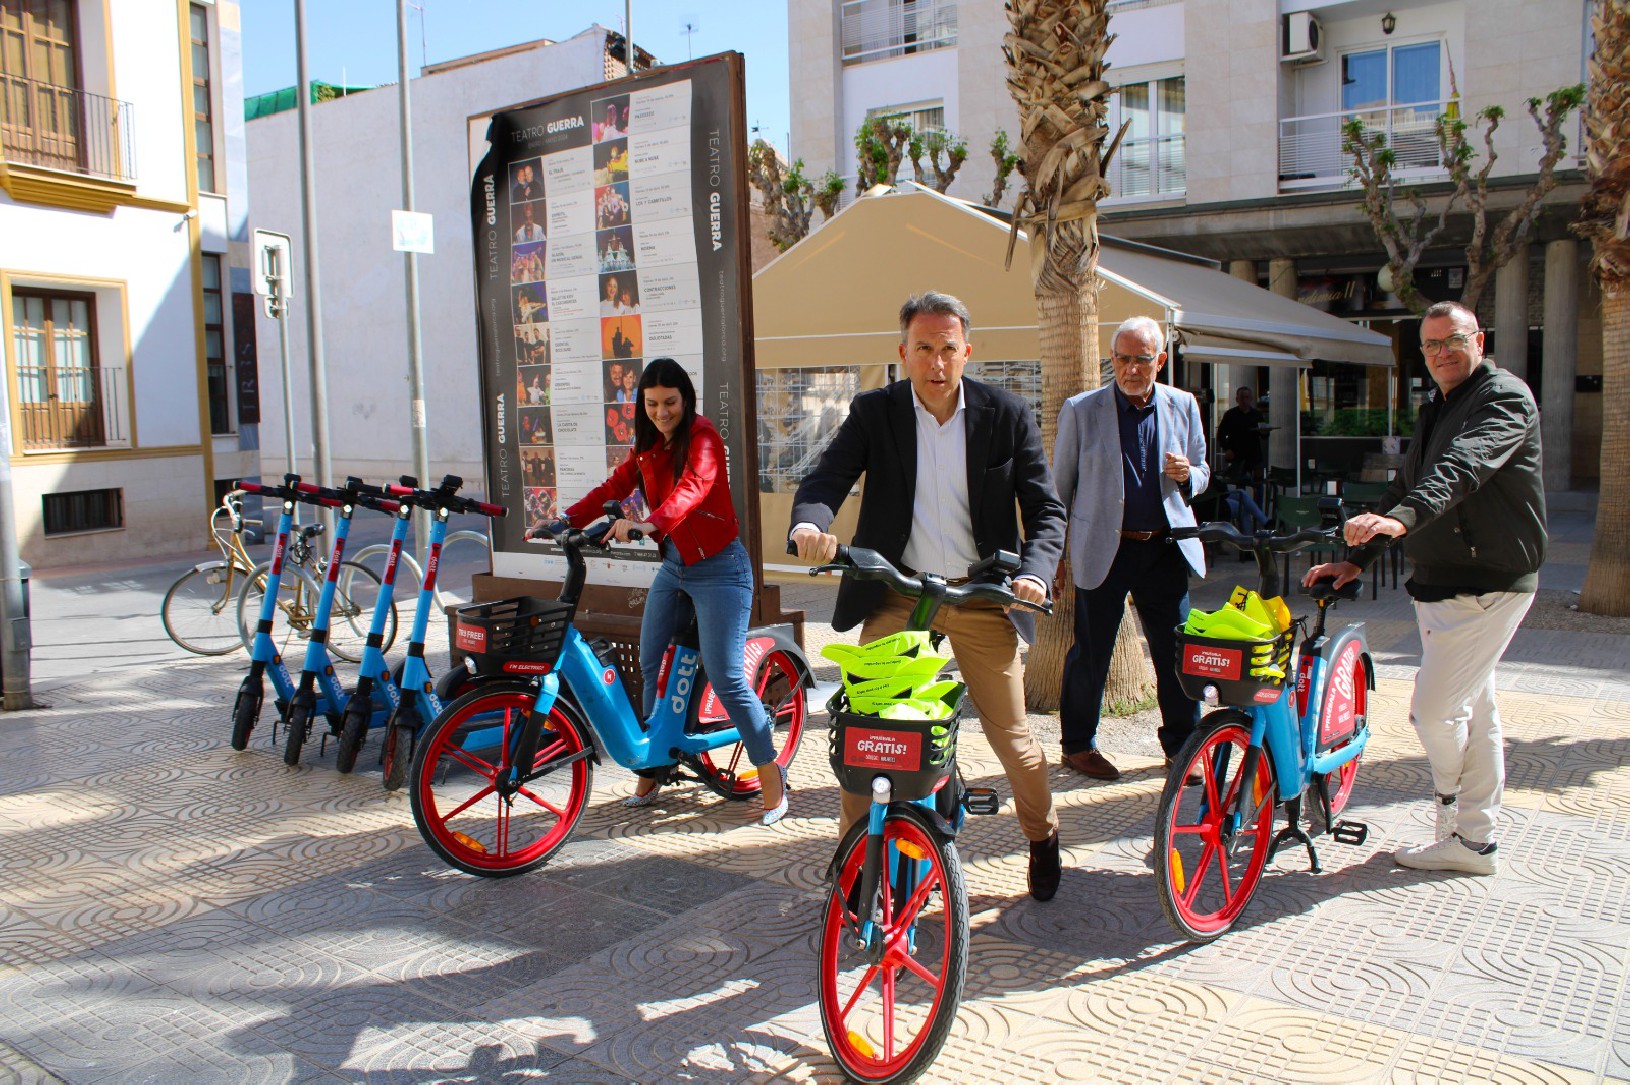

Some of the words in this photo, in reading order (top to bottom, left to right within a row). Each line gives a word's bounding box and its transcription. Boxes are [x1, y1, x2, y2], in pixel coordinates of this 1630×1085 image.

[511, 126, 545, 142] TEATRO
[547, 116, 584, 134] GUERRA
[709, 128, 720, 187] TEATRO
[483, 174, 497, 225] GUERRA
[710, 192, 722, 251] GUERRA
[489, 230, 499, 280] TEATRO
[497, 393, 506, 444] GUERRA
[719, 382, 730, 440] TEATRO
[500, 448, 510, 498] TEATRO
[389, 552, 397, 566] dott
[430, 556, 438, 573] dott
[467, 630, 484, 640] FREE!
[671, 654, 697, 714] dott
[1192, 654, 1230, 667] GRATIS!
[1297, 673, 1307, 692] dott
[857, 739, 907, 755] GRATIS!
